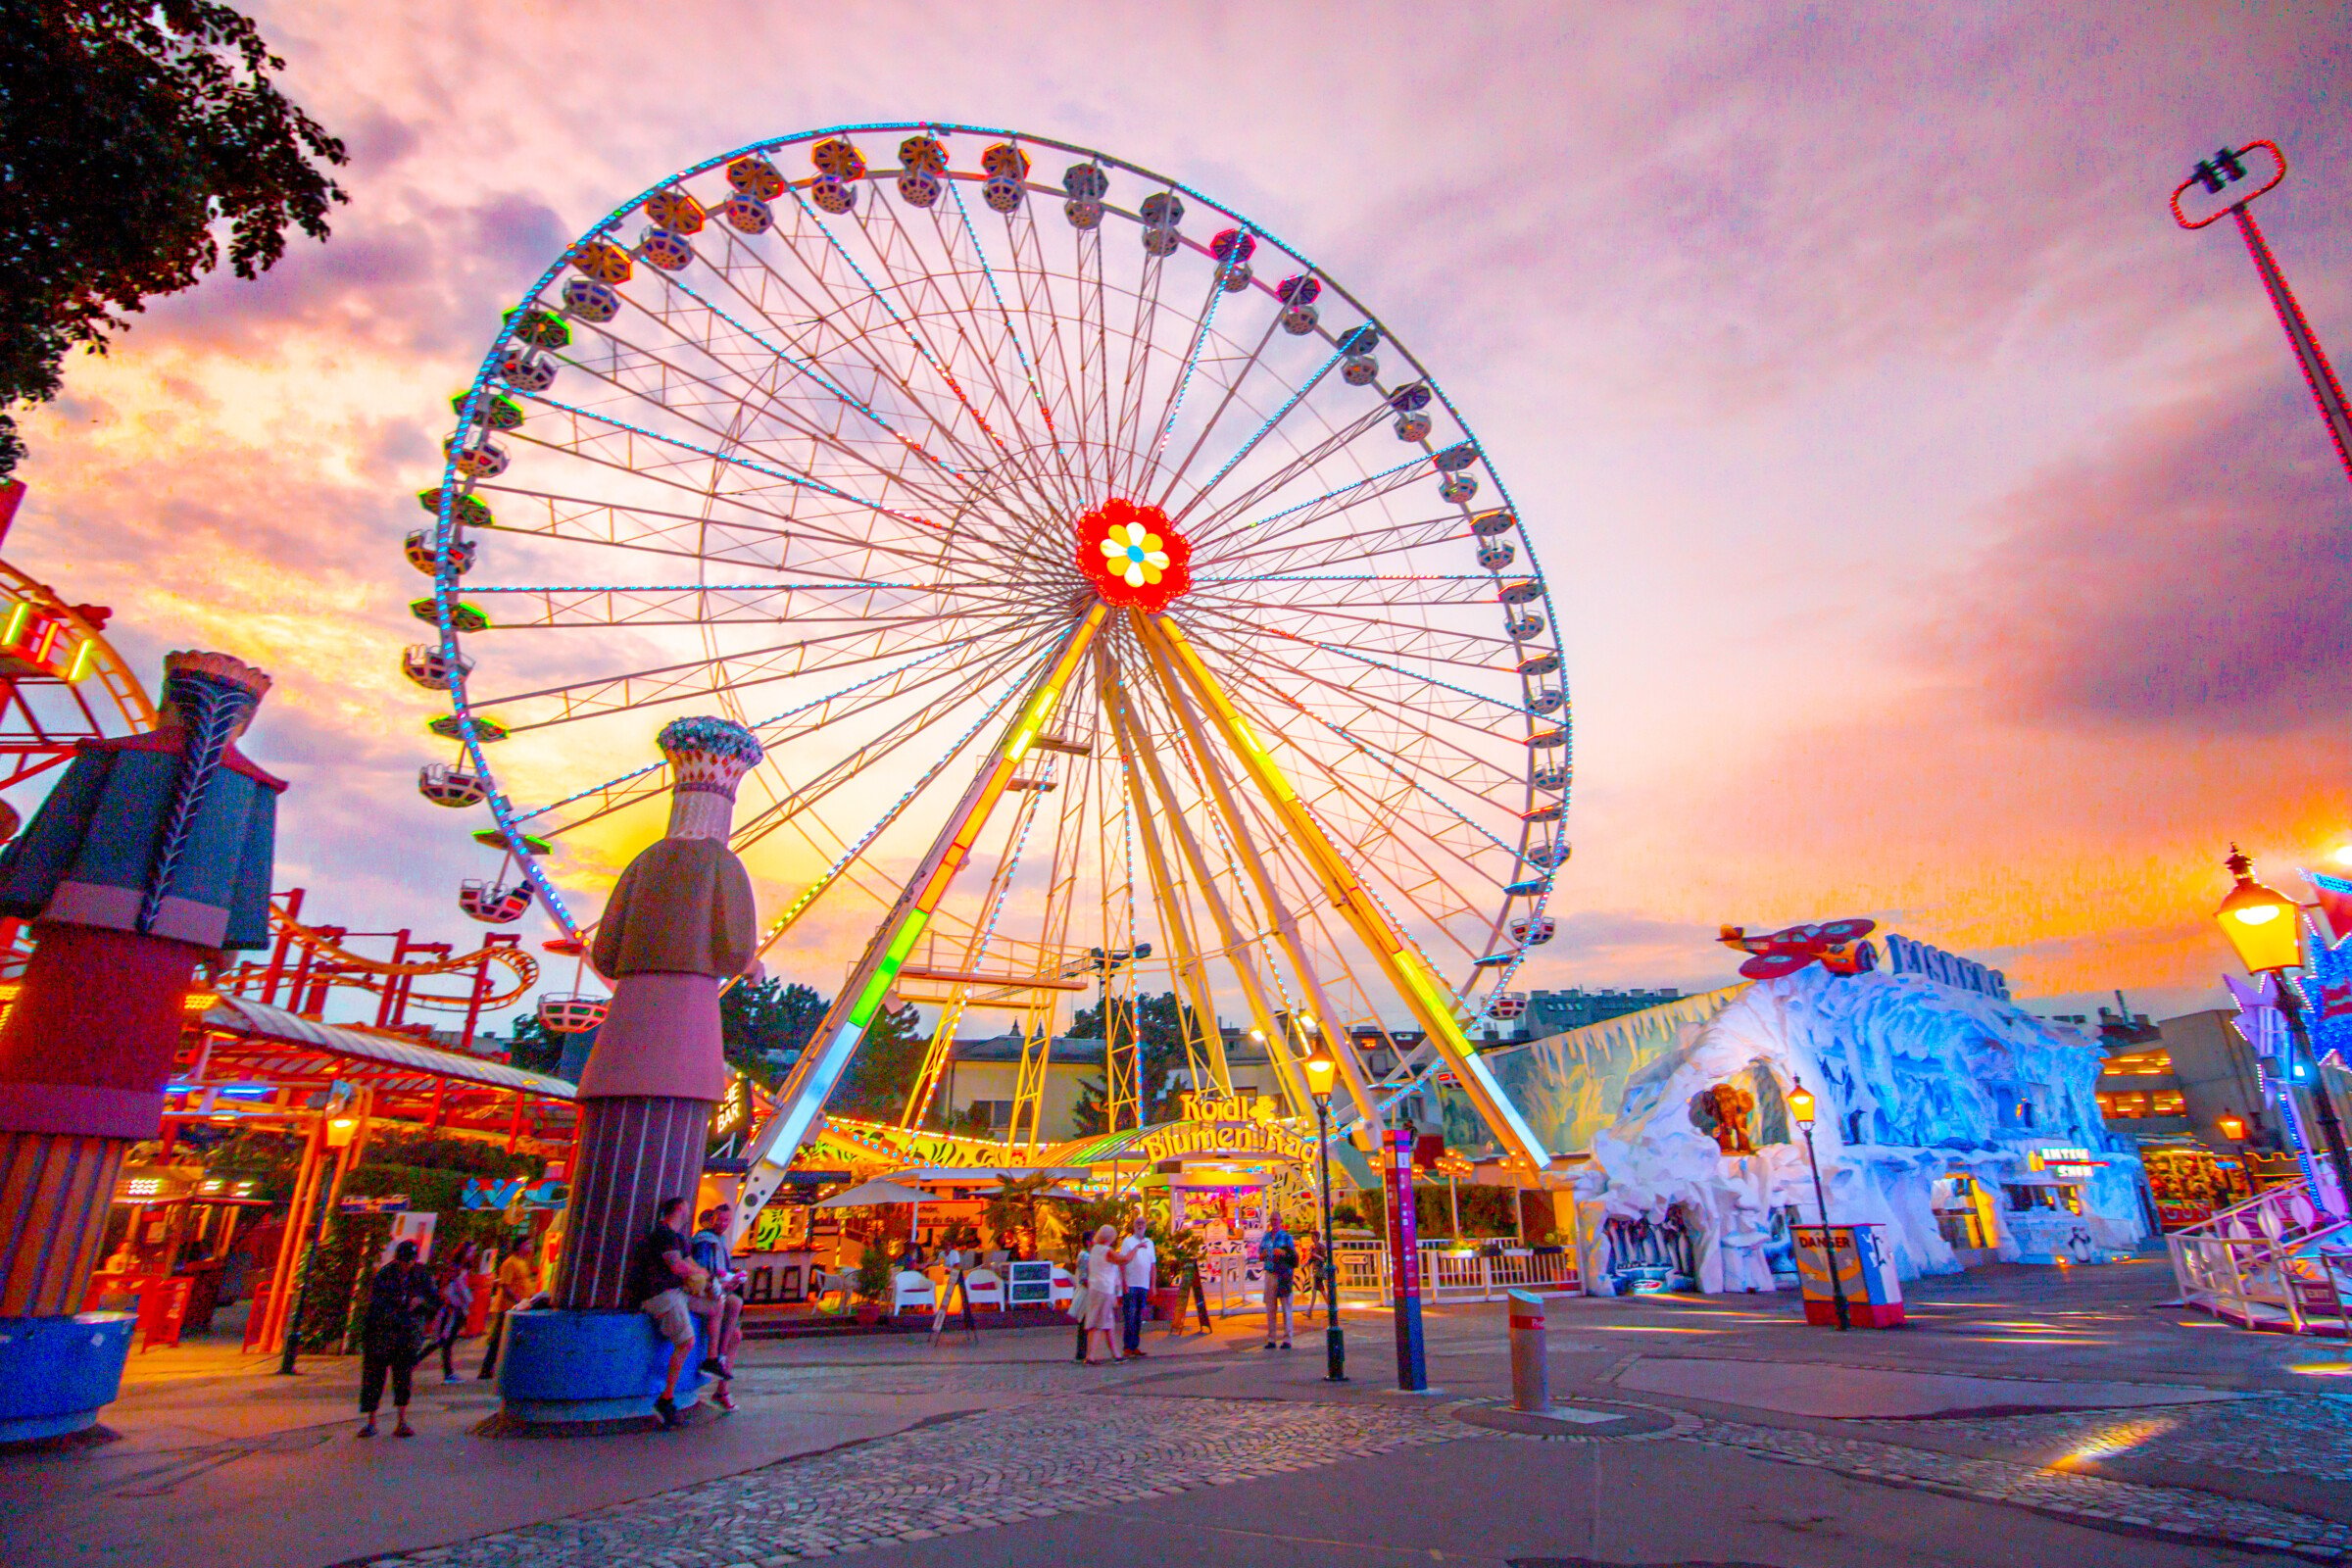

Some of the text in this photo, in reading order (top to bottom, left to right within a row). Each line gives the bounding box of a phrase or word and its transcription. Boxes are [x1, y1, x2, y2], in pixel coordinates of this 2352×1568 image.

[1886, 934, 2011, 1004] EISBERG
[717, 1102, 741, 1134] BAR
[1179, 1094, 1249, 1121] Koidl
[1141, 1123, 1319, 1165] Blumen Rad
[462, 1177, 569, 1210] WC
[1798, 1236, 1851, 1249] DANER
